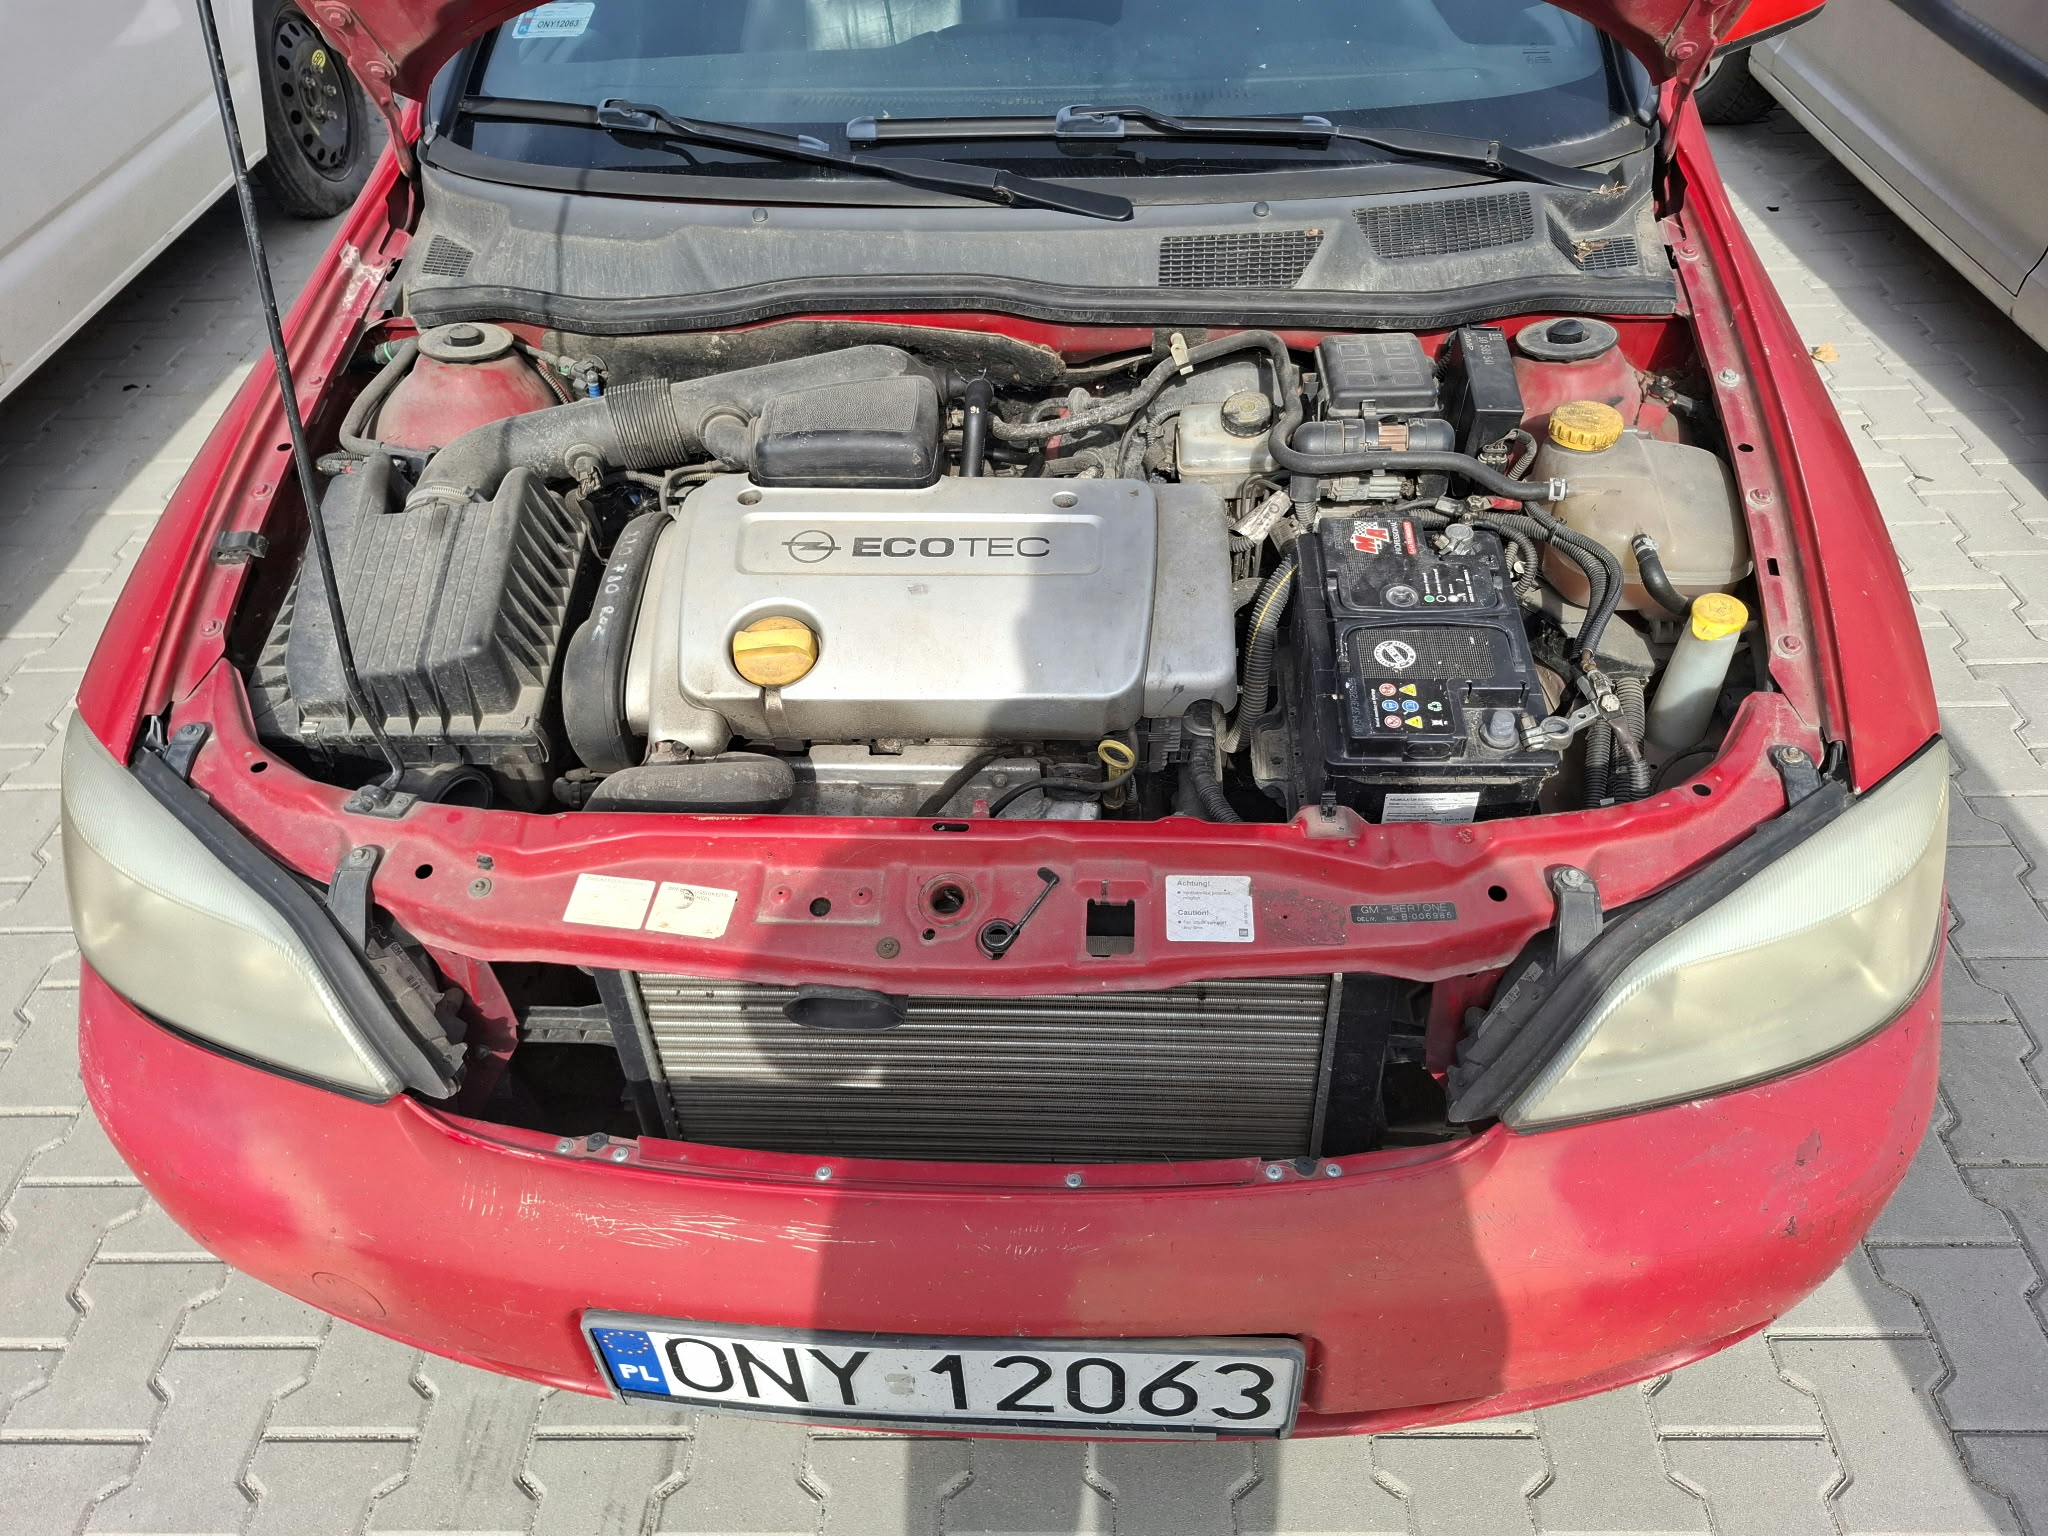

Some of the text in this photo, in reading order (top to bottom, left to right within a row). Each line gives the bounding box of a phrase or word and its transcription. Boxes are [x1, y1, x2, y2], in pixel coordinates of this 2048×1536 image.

[537, 19, 579, 28] ONY12063
[852, 536, 1050, 558] ECOTEC
[1177, 880, 1210, 888] Achtung!
[1360, 905, 1379, 914] GM
[1391, 902, 1448, 914] BERTONE
[621, 1363, 660, 1383] PL
[664, 1336, 1276, 1421] ONY 12063
